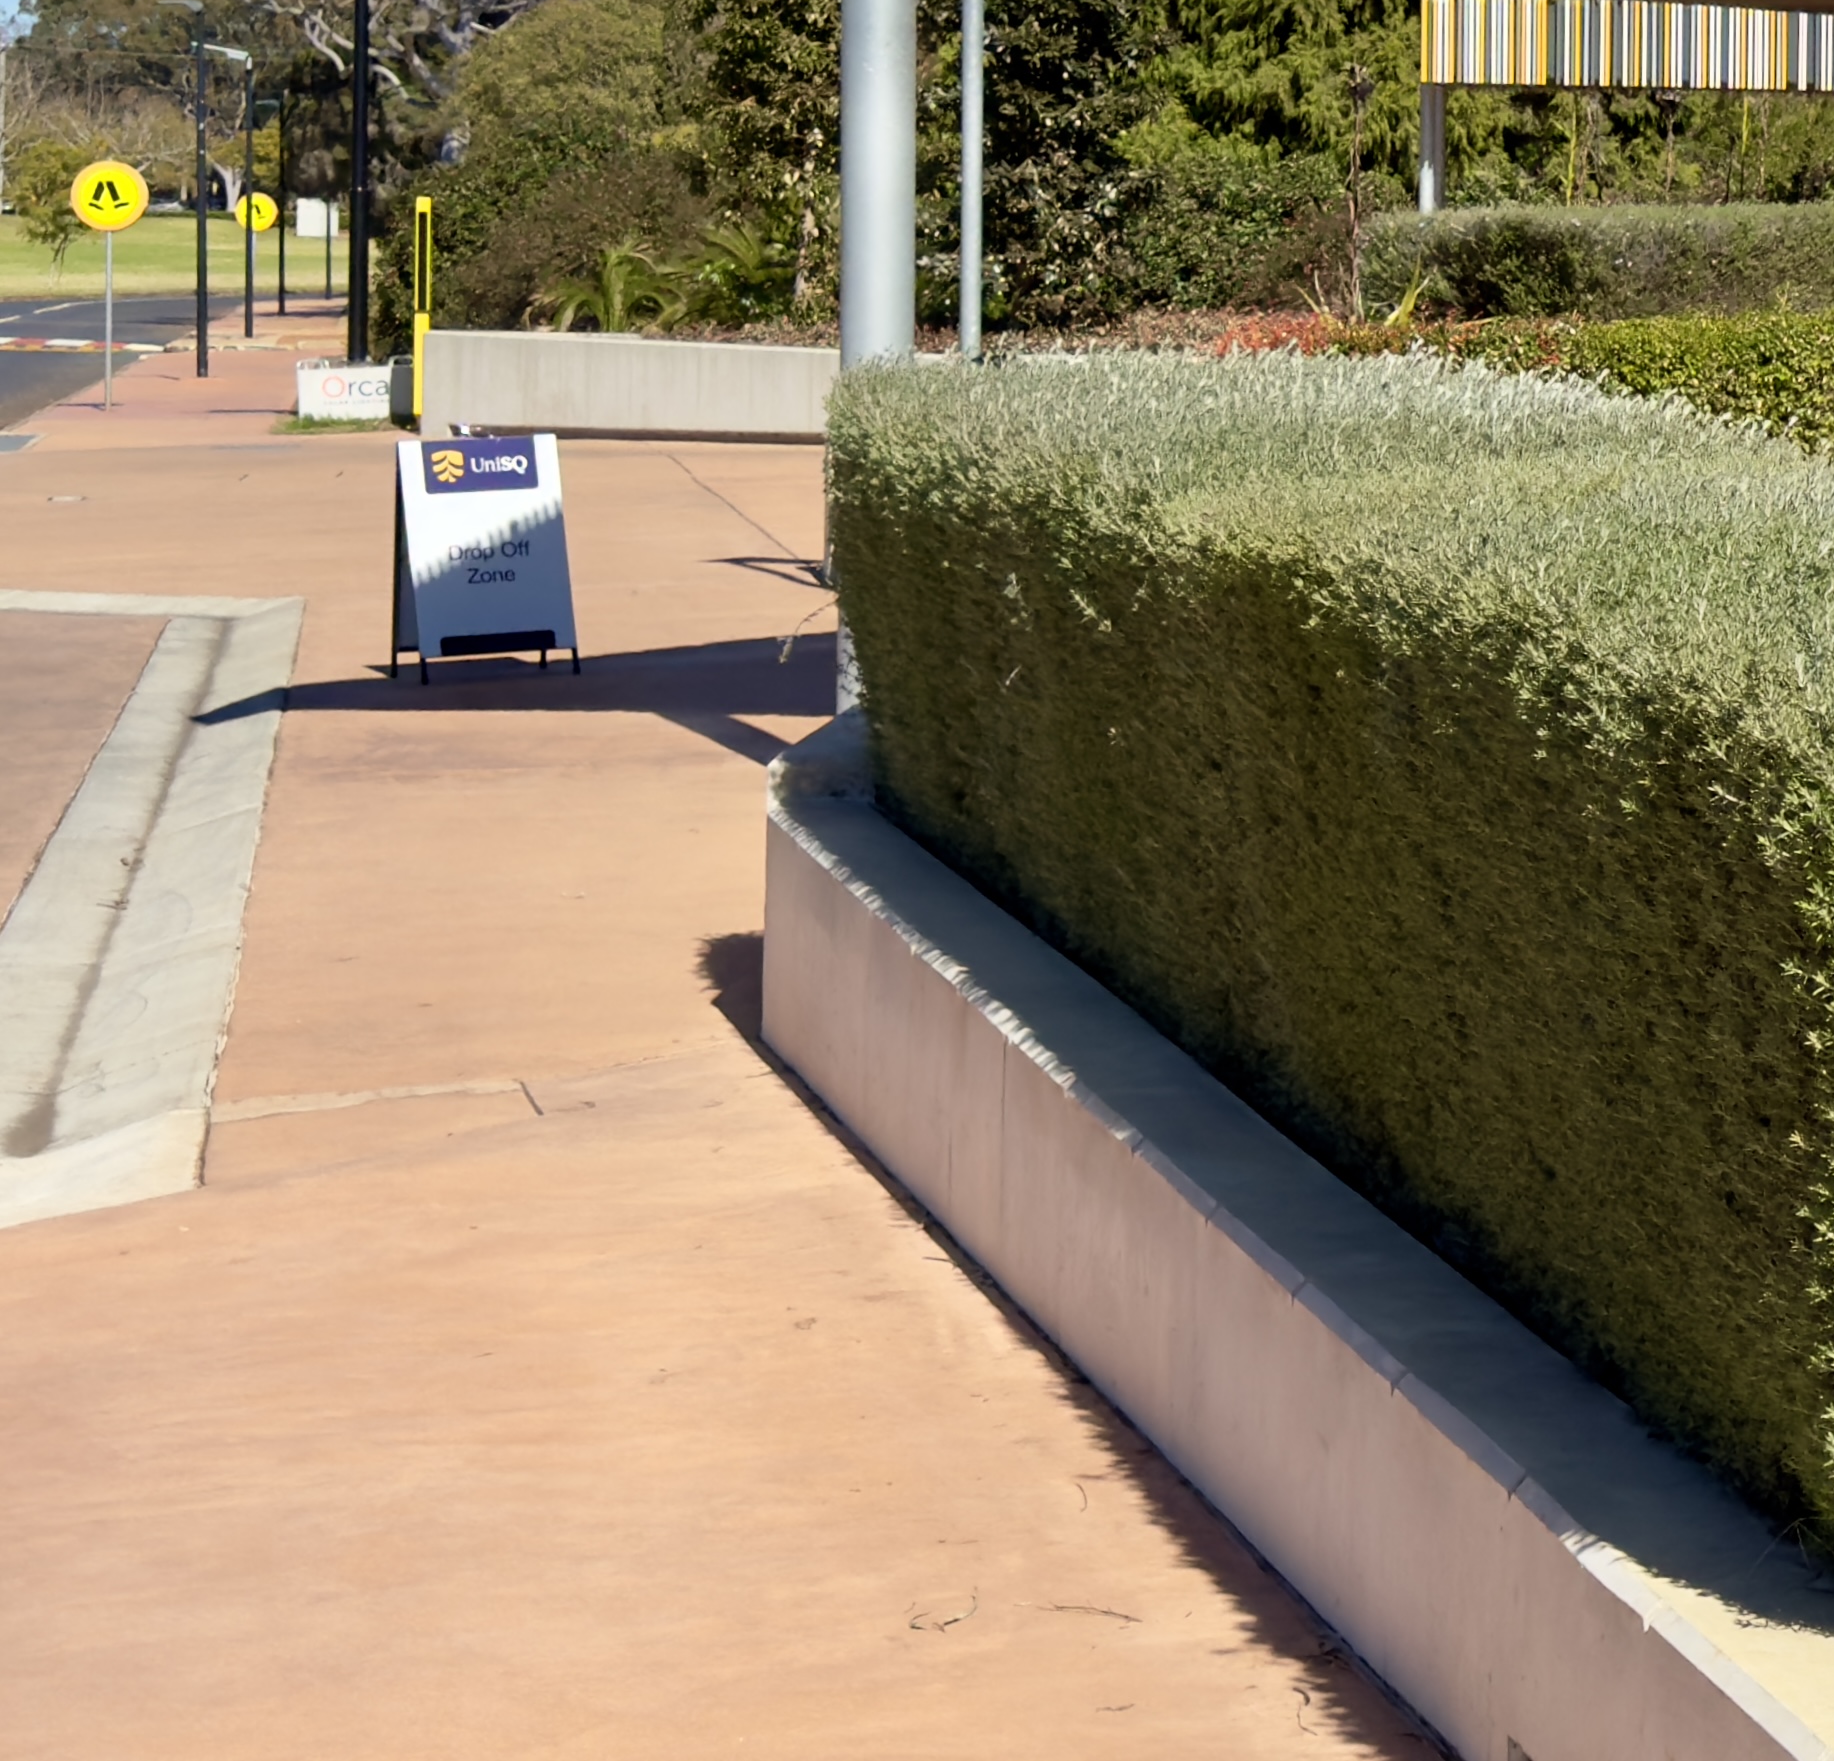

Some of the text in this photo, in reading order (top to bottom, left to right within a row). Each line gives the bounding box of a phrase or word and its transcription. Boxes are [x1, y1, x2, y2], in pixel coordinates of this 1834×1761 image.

[322, 375, 390, 398] Orca
[470, 455, 528, 474] UniSQ
[449, 541, 530, 561] Drop Off
[467, 567, 516, 584] Zone
